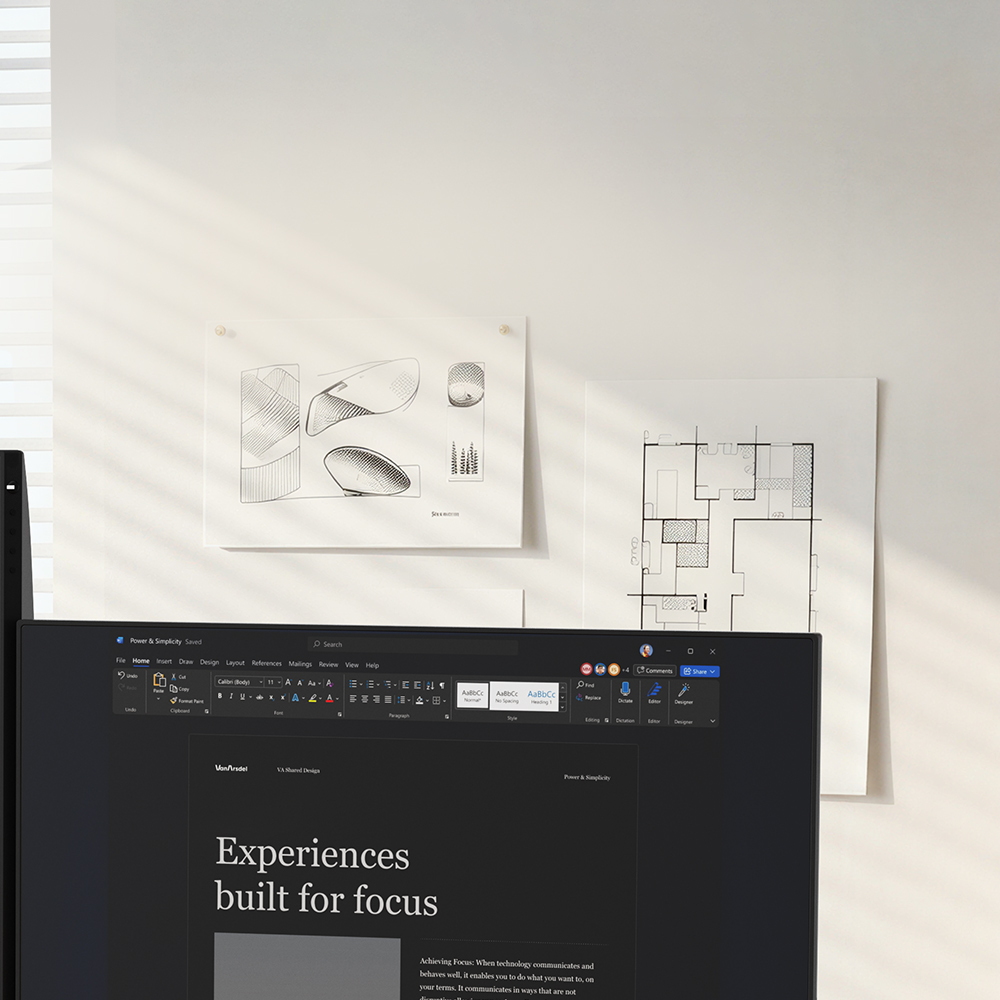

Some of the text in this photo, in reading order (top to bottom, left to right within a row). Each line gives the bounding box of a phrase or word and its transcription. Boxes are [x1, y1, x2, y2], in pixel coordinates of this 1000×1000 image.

[155, 638, 182, 646] Simplicity
[216, 837, 409, 874] Experiences
[214, 880, 438, 916] built for focus
[420, 958, 452, 966] Achieving
[497, 960, 532, 969] technology
